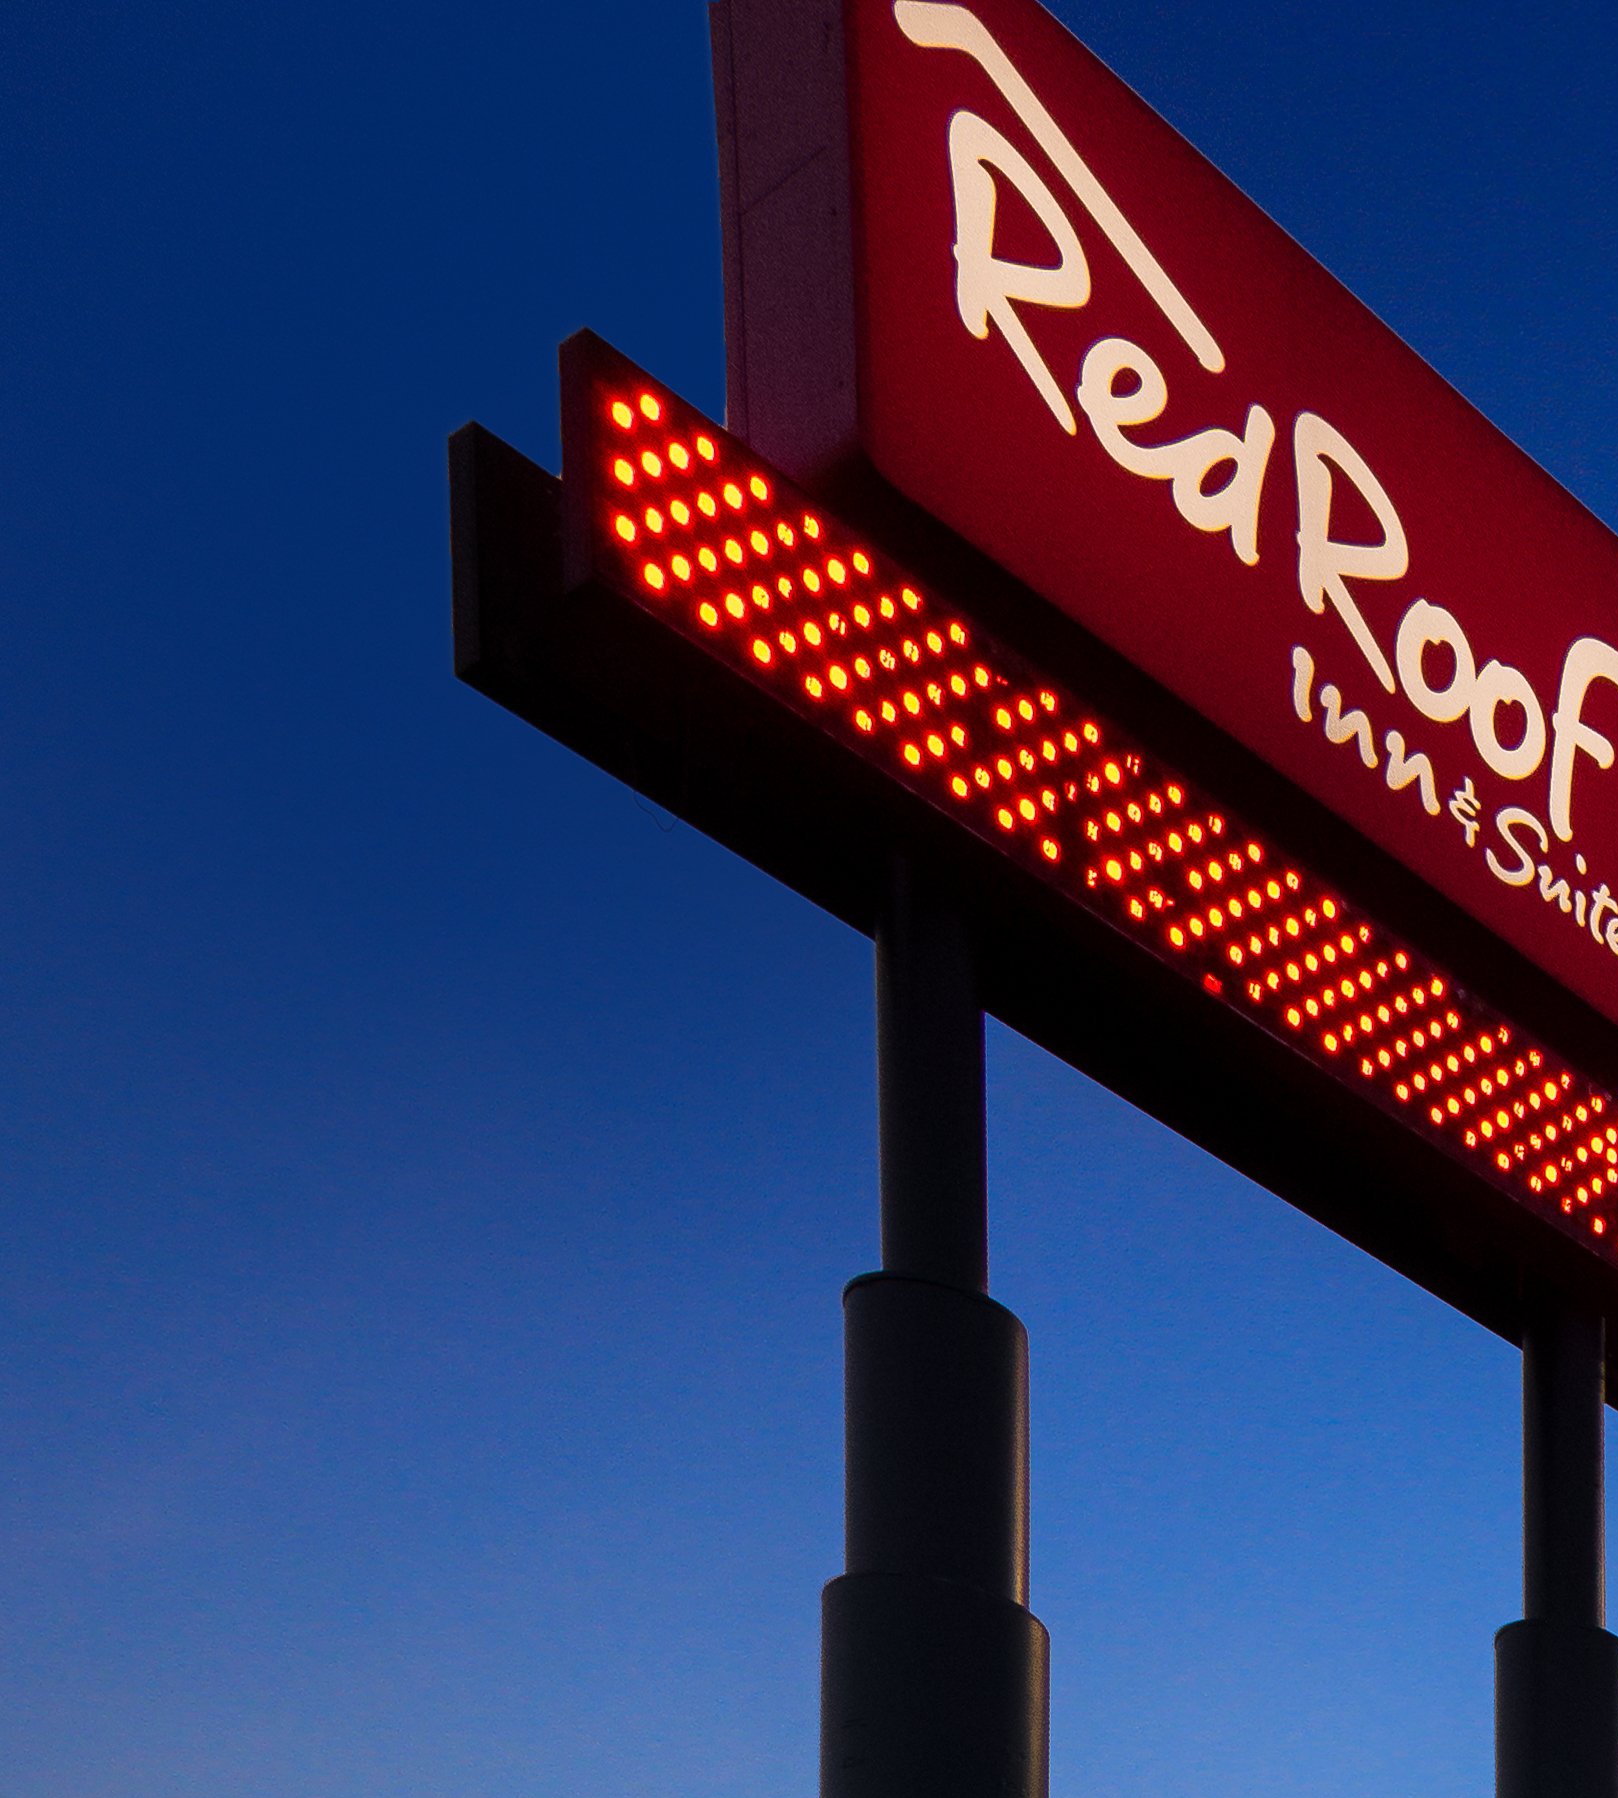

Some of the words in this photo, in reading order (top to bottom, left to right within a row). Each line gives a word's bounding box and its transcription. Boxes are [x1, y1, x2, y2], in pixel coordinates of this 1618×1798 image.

[948, 110, 1275, 566] Red
[1291, 645, 1441, 814] Inn
[1447, 777, 1481, 846] &
